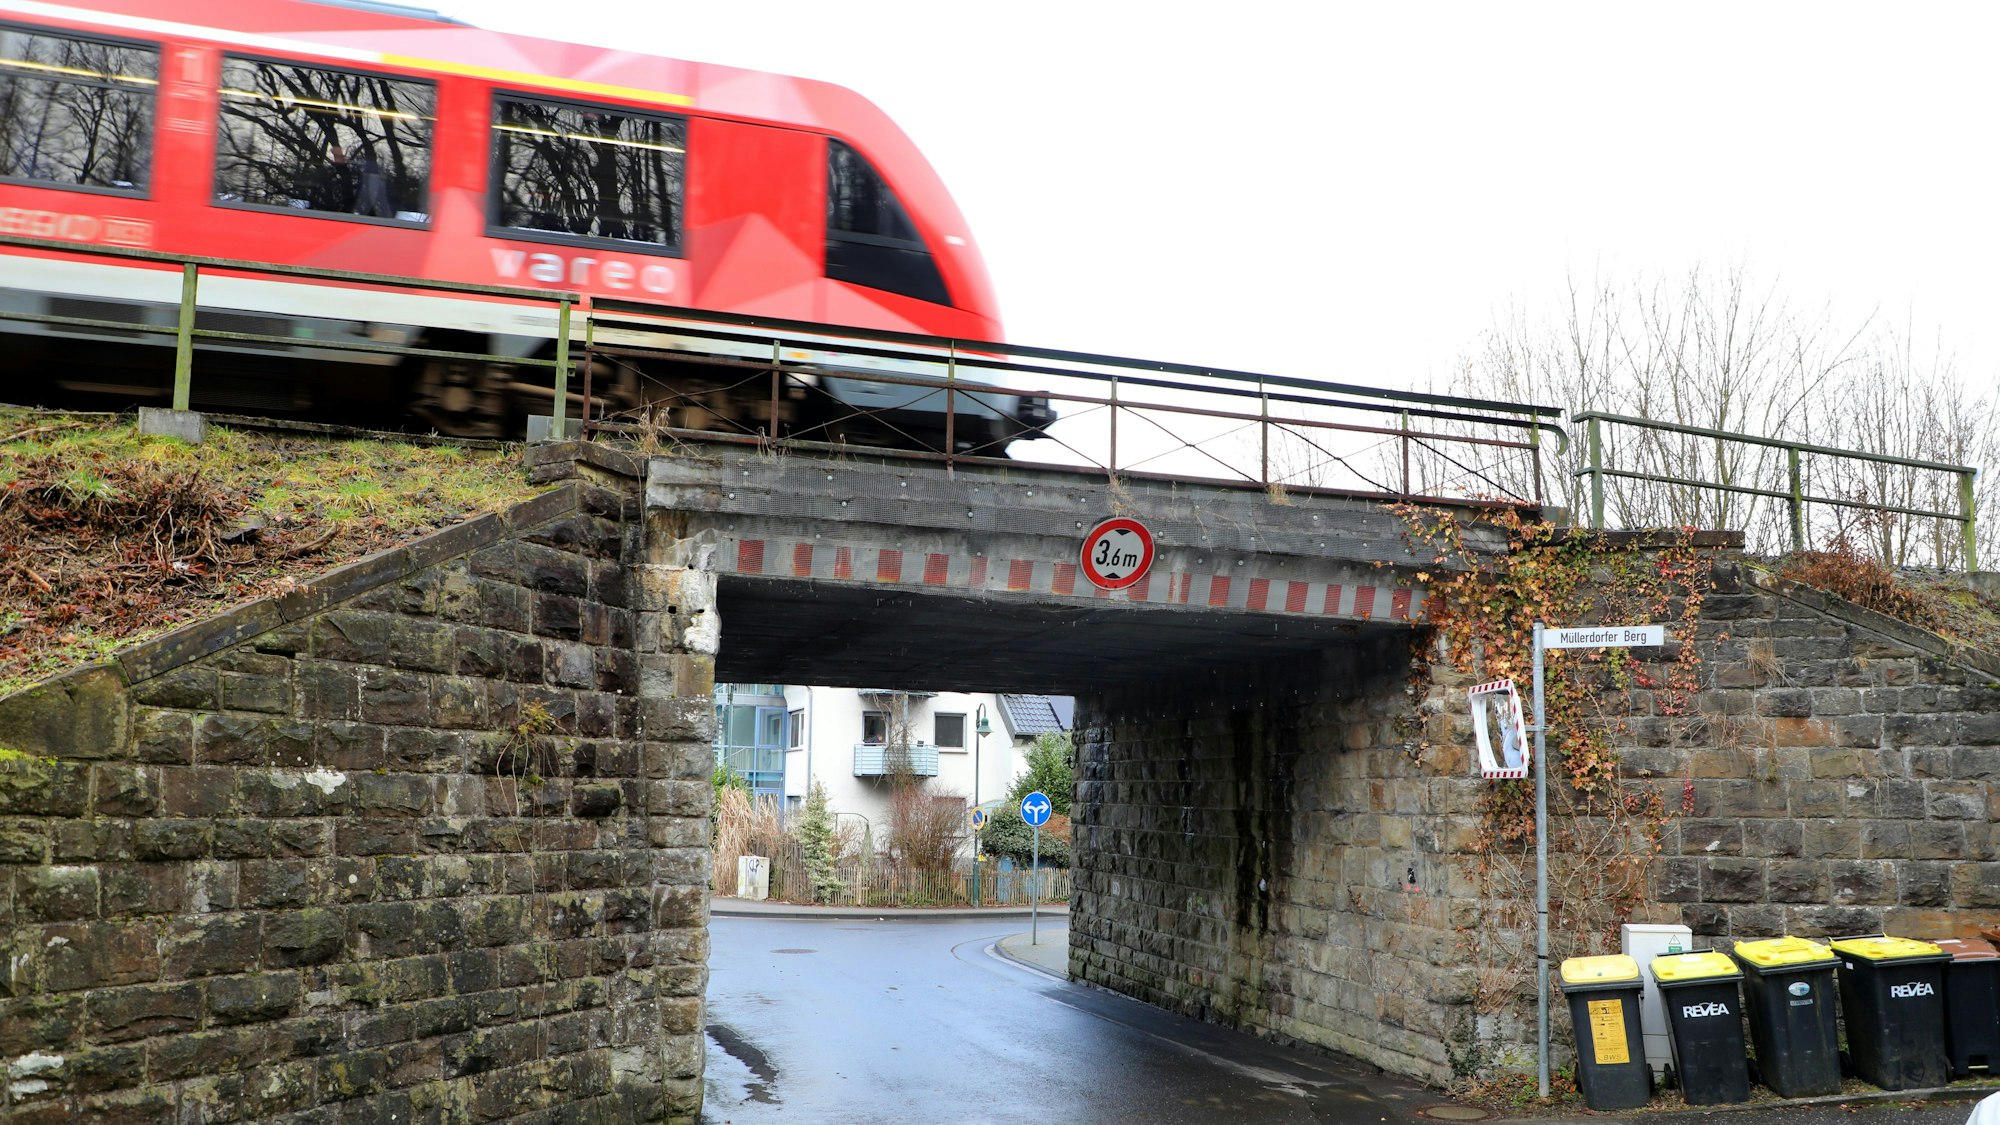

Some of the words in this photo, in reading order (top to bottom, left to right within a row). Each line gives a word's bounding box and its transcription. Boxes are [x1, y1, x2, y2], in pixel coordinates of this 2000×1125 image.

[490, 248, 676, 294] vareo
[1095, 539, 1121, 567] 3,6
[1122, 553, 1138, 568] m
[1560, 631, 1619, 644] Müllerdorfer
[1624, 630, 1647, 644] Berg
[1890, 981, 1935, 999] REVEA
[1682, 1001, 1730, 1019] REVEA
